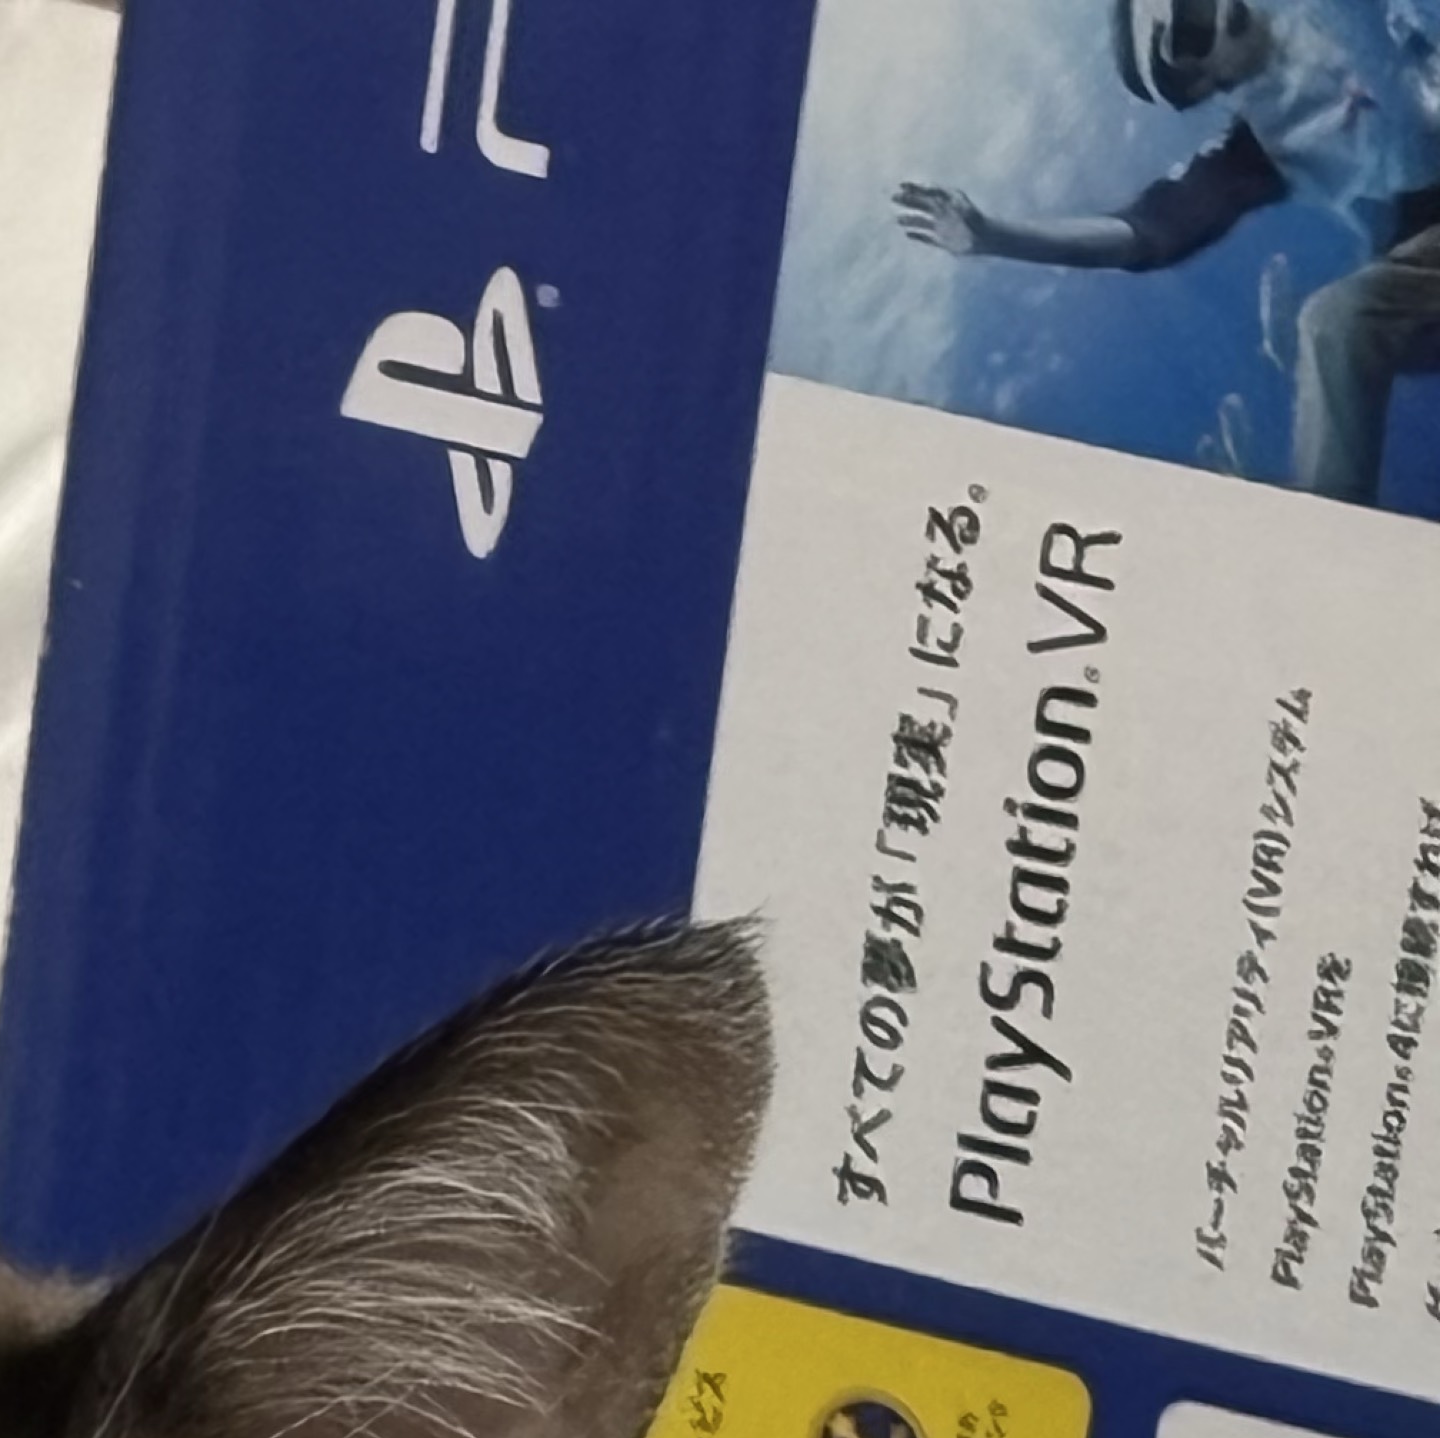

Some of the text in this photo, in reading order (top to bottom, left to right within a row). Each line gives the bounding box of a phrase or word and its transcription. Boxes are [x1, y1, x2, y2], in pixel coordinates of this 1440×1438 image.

[832, 485, 985, 1205] すべての夢が「現実」になる。
